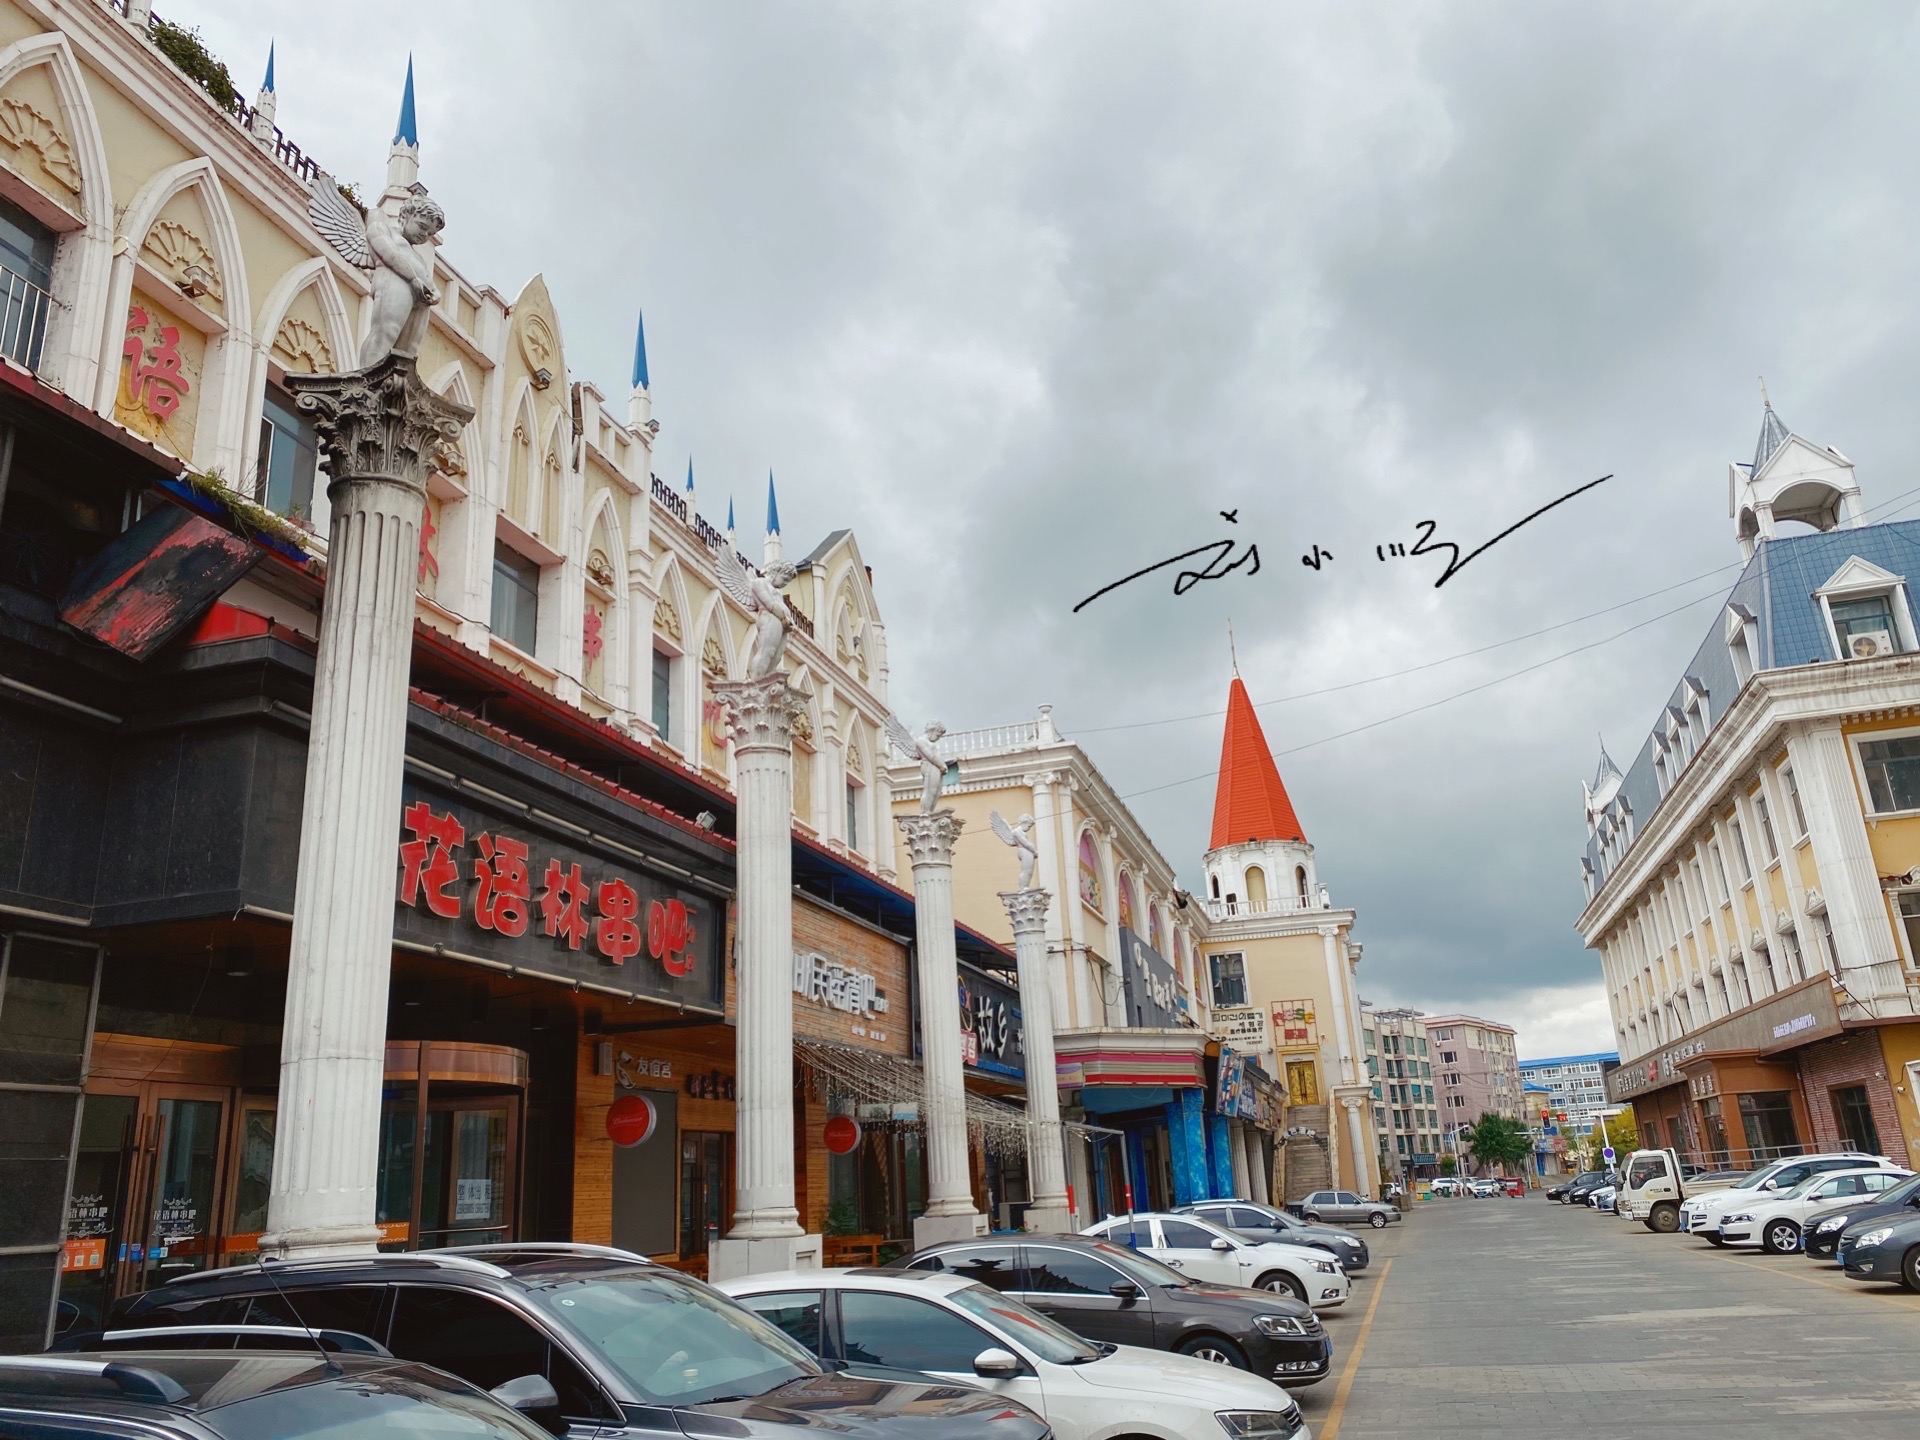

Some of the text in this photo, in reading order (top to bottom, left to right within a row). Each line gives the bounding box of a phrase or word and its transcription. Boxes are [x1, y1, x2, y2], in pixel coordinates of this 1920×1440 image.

[123, 306, 190, 422] 语
[399, 800, 688, 978] 花语林串吧
[976, 996, 1008, 1059] 故乡
